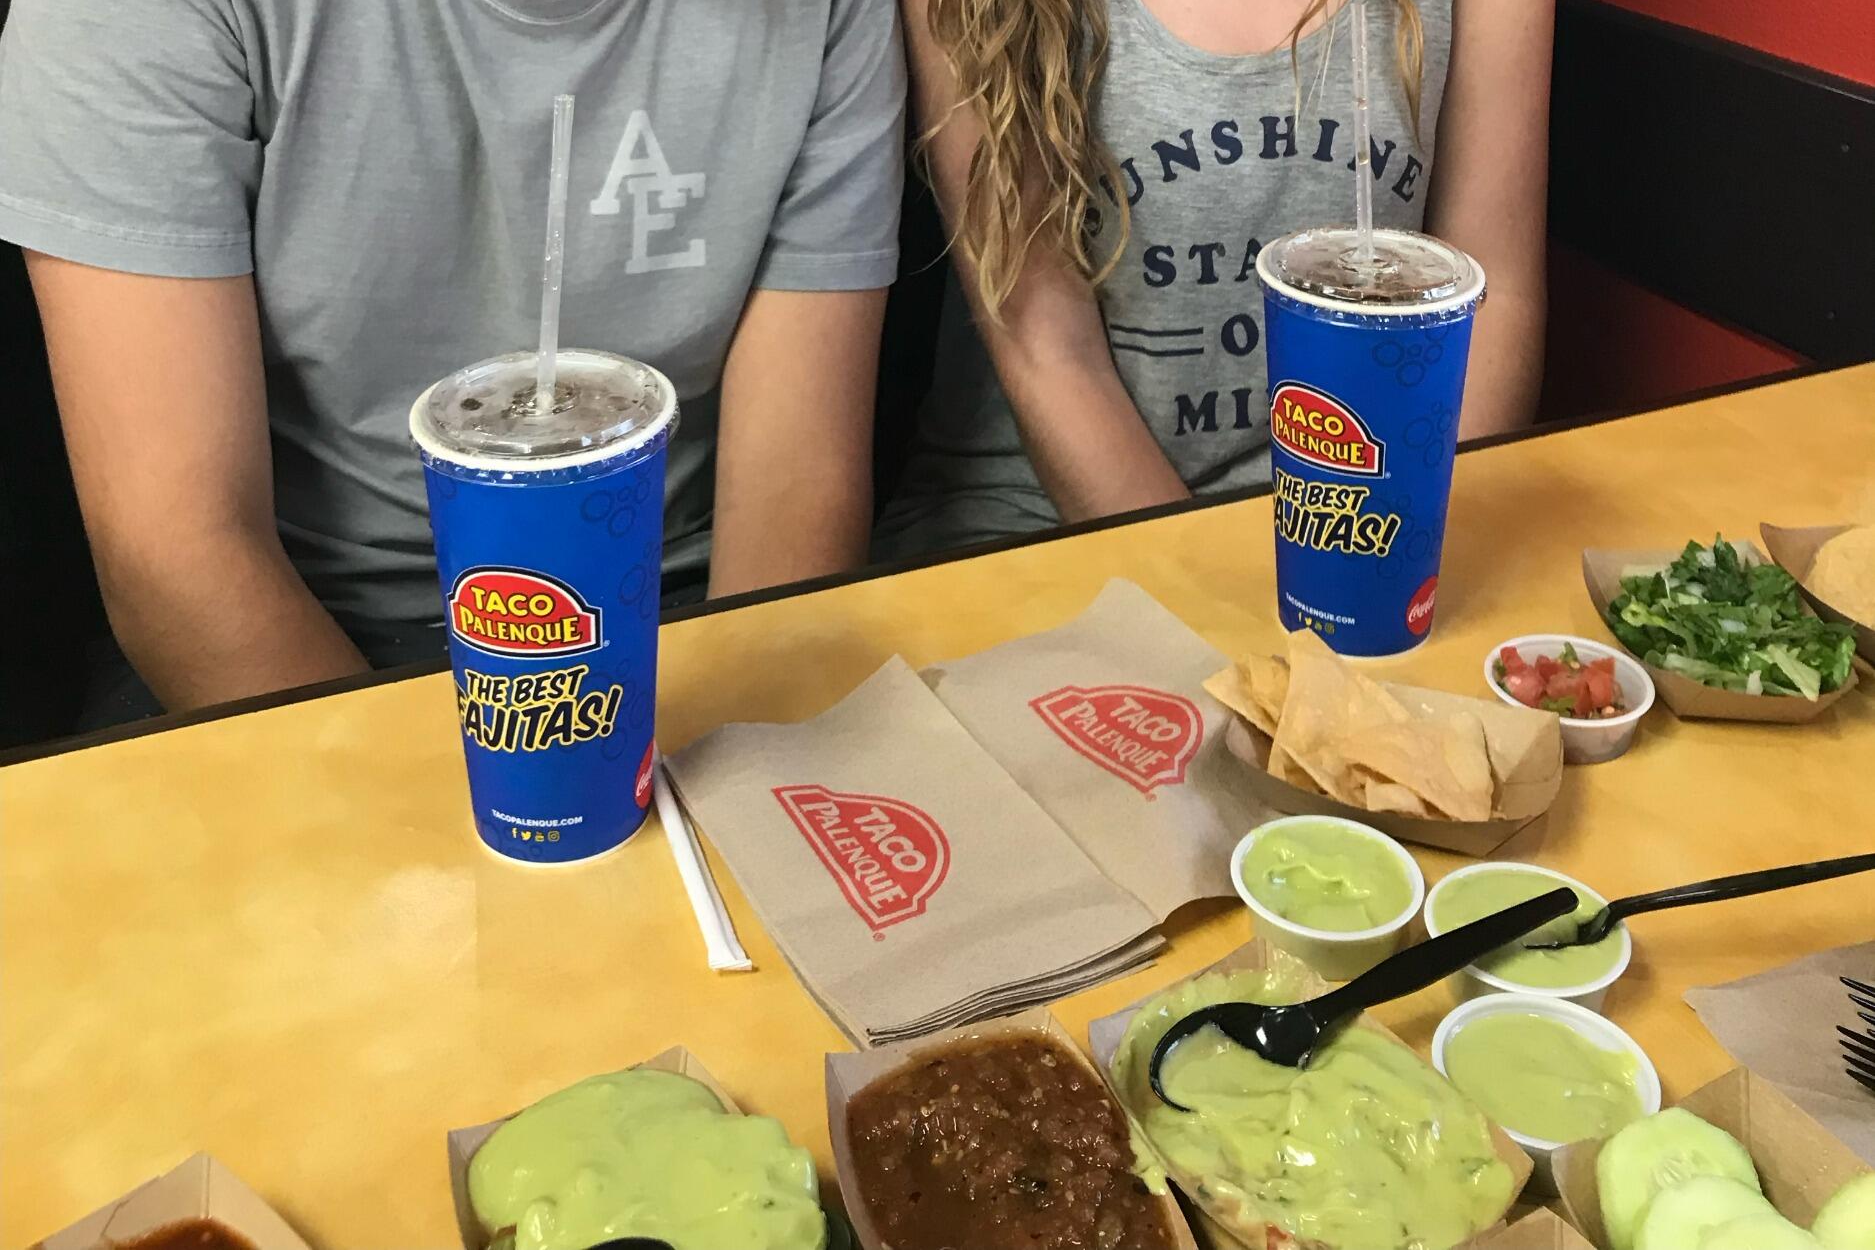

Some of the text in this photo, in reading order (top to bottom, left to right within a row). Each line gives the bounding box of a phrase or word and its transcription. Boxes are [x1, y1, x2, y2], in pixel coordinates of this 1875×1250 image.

[1143, 237, 1263, 288] STA
[1220, 313, 1260, 357] O
[1174, 387, 1268, 436] MI
[1282, 397, 1345, 437] TACO
[1274, 412, 1366, 466] PALENQUE
[1276, 467, 1370, 514] THE BEST
[1274, 496, 1401, 557] AJITAS!
[458, 603, 582, 646] PALENQUE
[469, 585, 555, 618] TACO
[465, 664, 589, 708] THE BEST
[1058, 700, 1169, 773] PALENQUE
[1109, 696, 1182, 742] TACO
[799, 800, 908, 910] PALENQUE
[853, 805, 927, 873] TACO
